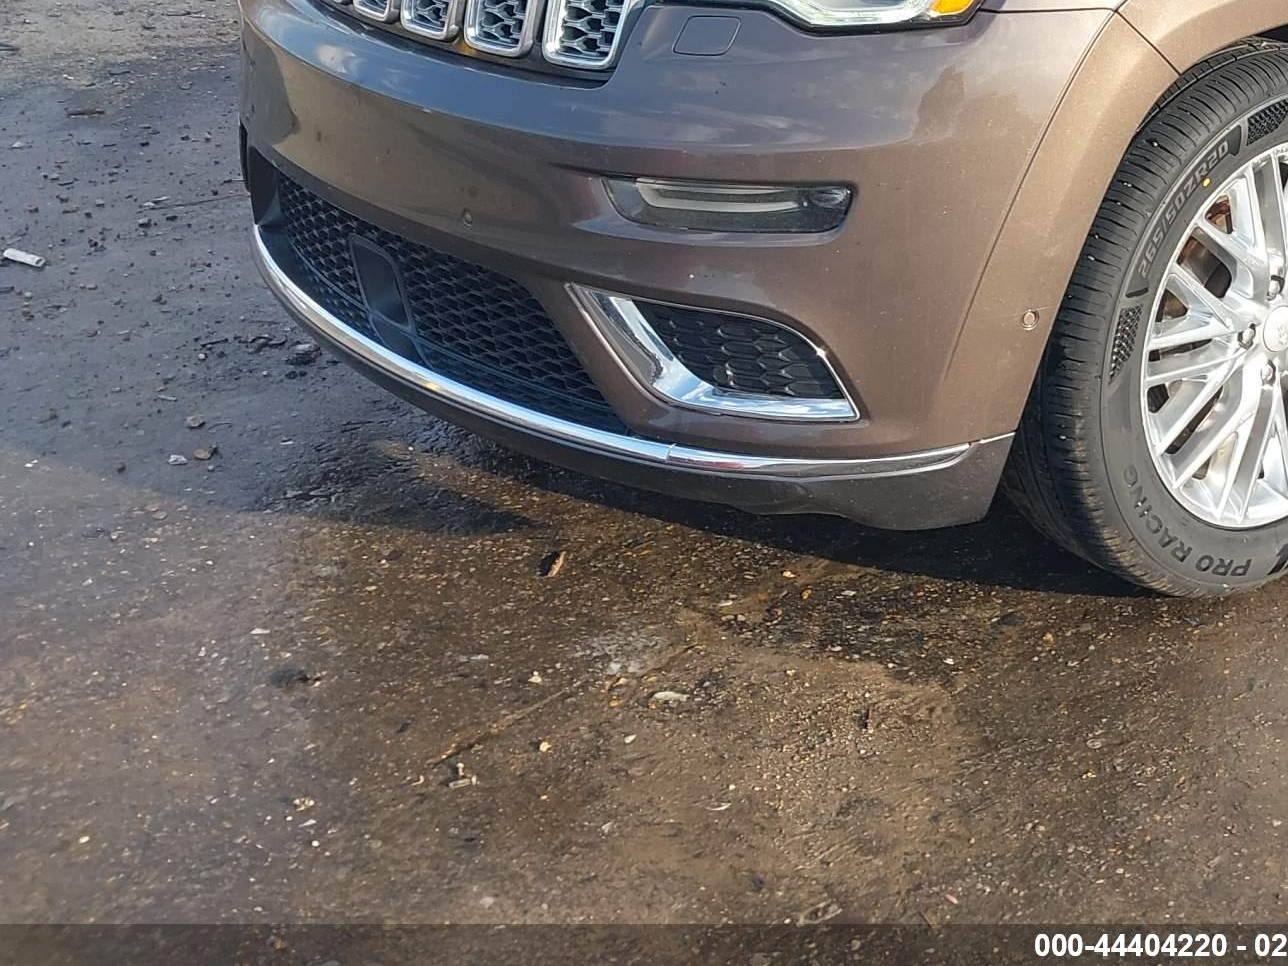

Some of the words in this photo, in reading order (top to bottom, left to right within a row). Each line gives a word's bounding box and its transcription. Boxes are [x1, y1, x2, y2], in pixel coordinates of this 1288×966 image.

[1138, 140, 1230, 279] 265/50ZR20
[1123, 465, 1193, 563] RACING
[1195, 554, 1252, 577] PRO
